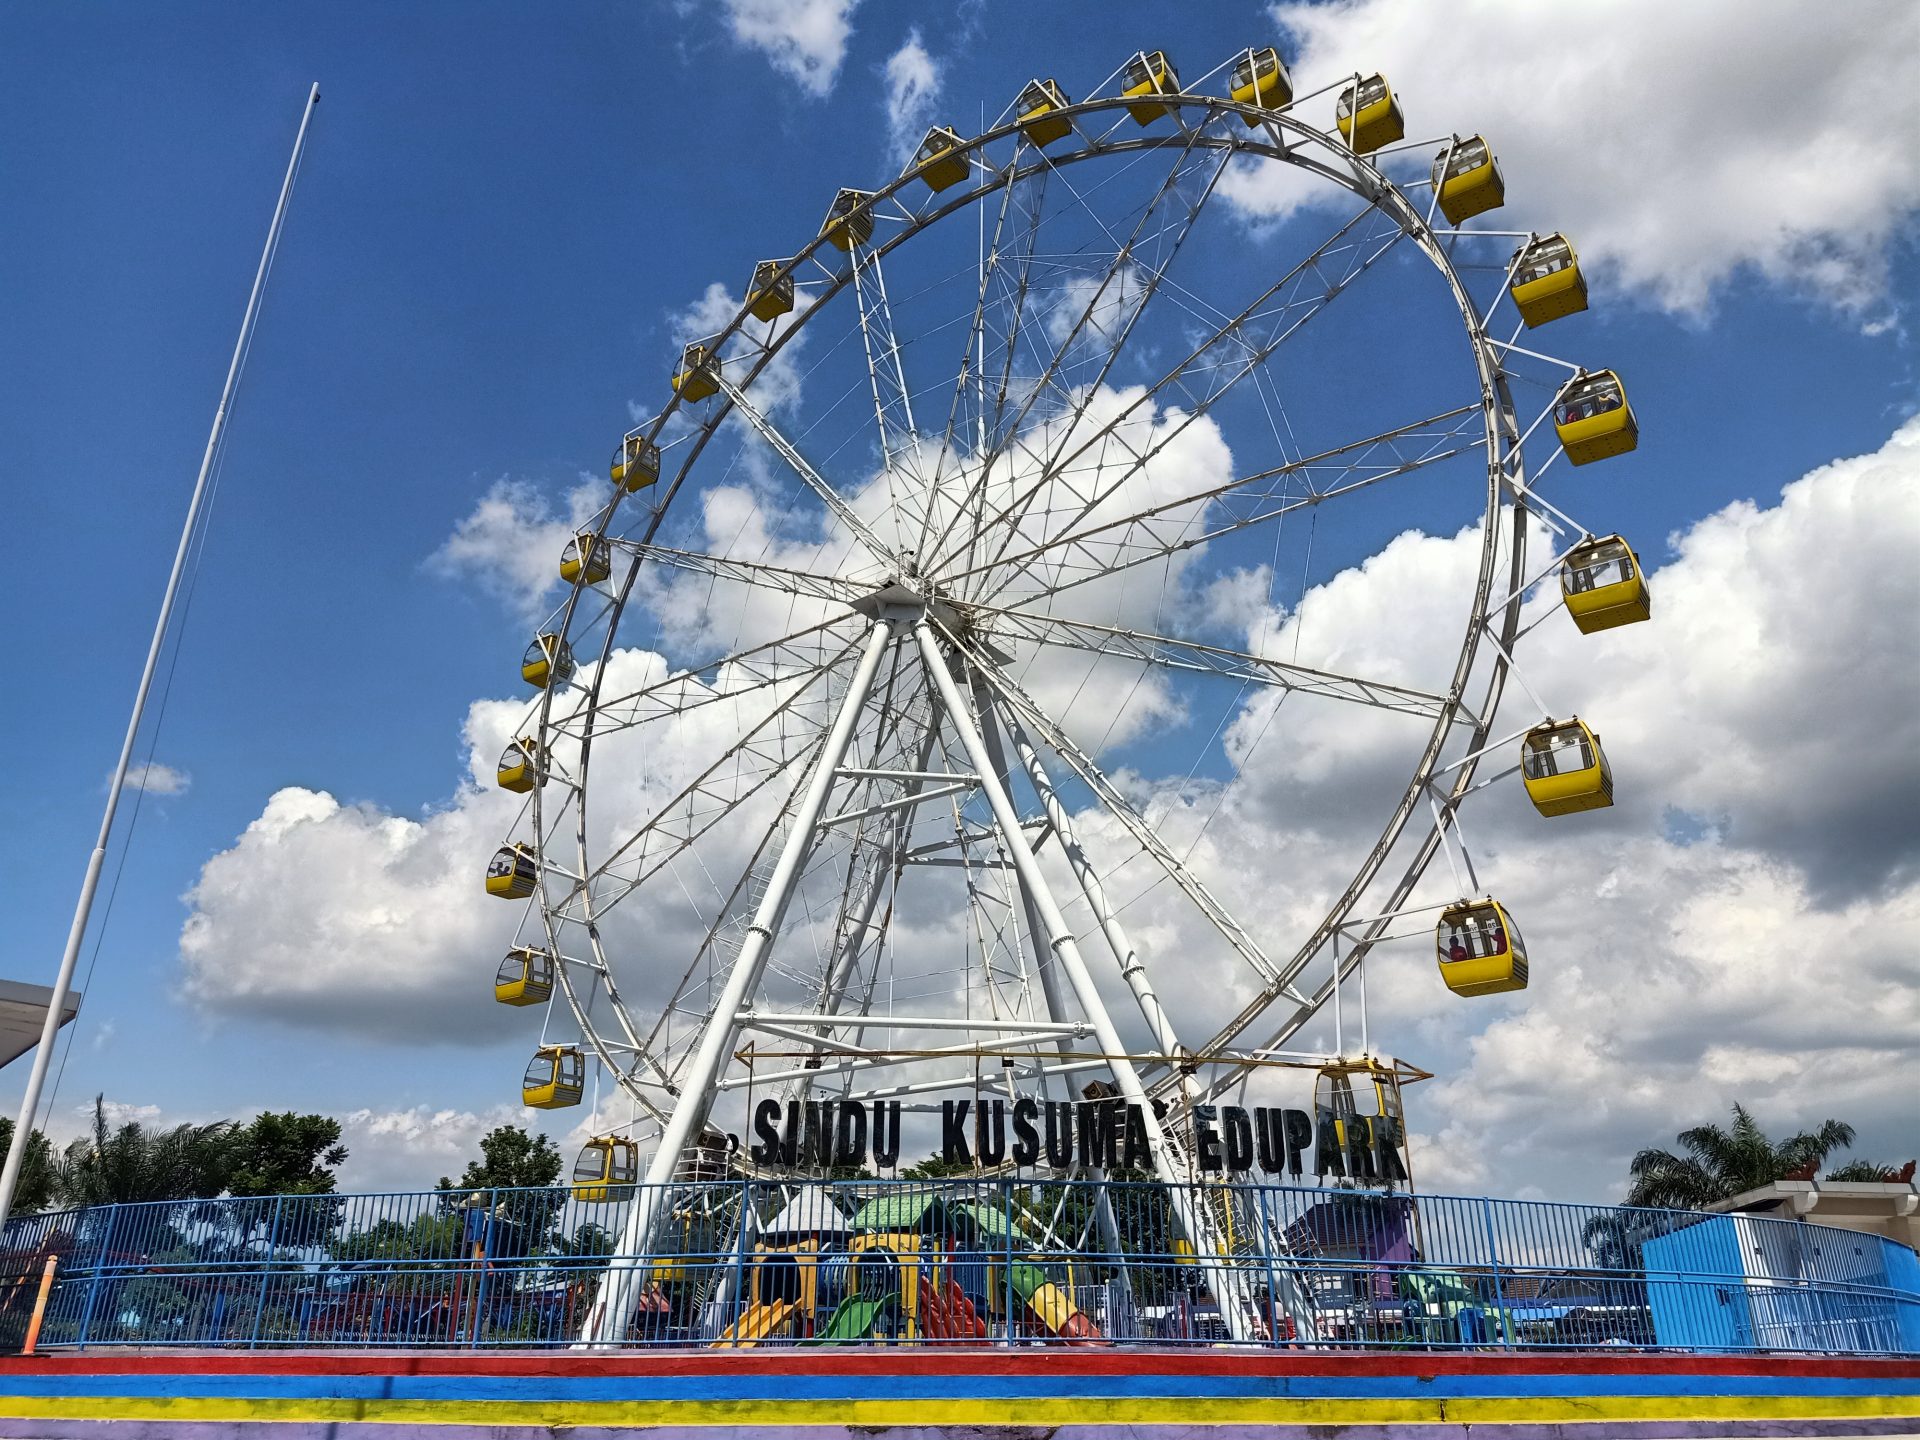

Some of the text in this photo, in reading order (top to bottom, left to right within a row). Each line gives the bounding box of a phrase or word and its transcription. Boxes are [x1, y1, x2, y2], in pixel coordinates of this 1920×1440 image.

[751, 1098, 1408, 1181] SINDU KUSUMA EDUPARK
